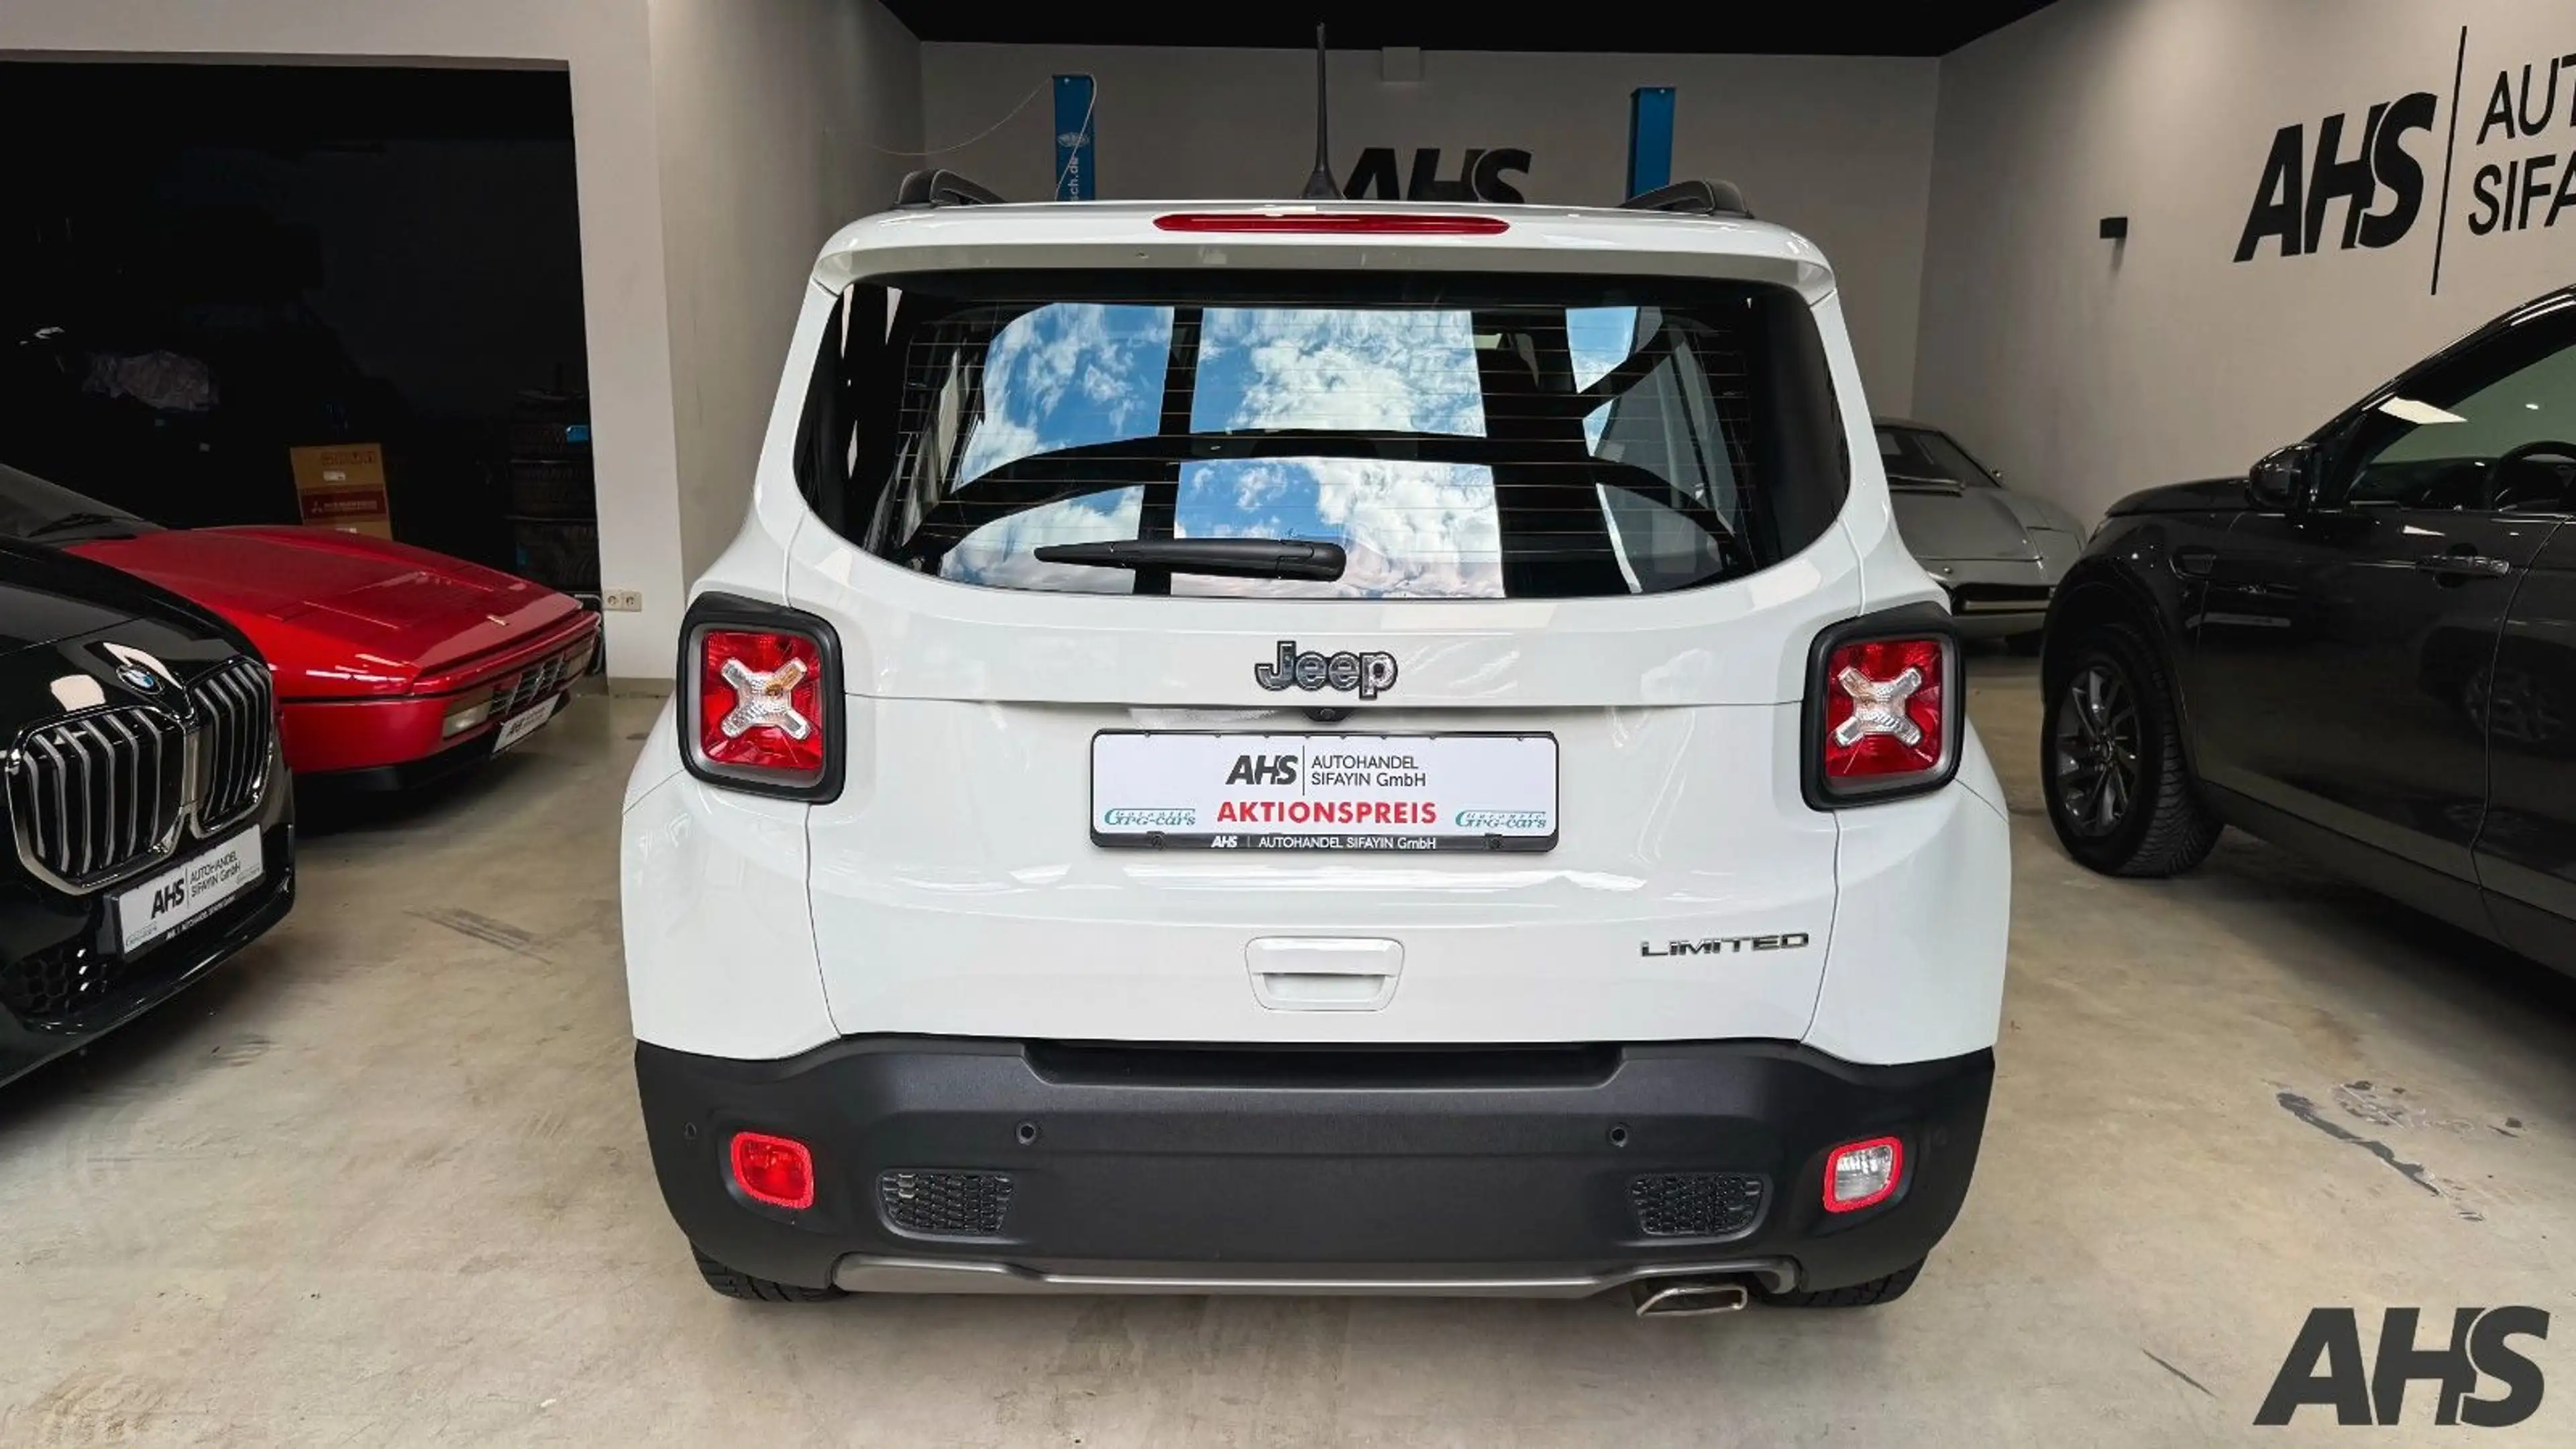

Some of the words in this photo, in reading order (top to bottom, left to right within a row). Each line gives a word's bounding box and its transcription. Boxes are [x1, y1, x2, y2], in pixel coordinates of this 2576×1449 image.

[1342, 147, 1532, 203] AHS
[2233, 92, 2438, 263] AHS
[1254, 640, 1398, 700] Jeep
[1225, 755, 1299, 785] AHS
[1311, 755, 1419, 769] AUTOHANDEL
[1311, 773, 1371, 786] SIFAYIN
[1377, 773, 1427, 787] GmbH
[1216, 801, 1438, 824] AKTIONSPREIS
[1210, 836, 1238, 849] AHS
[1258, 836, 1344, 849] AUTOHANDEL
[1346, 837, 1394, 849] SIFAYIN
[1397, 837, 1437, 850] GmbH
[151, 877, 185, 920] AHS
[1641, 932, 1809, 957] LIMITED
